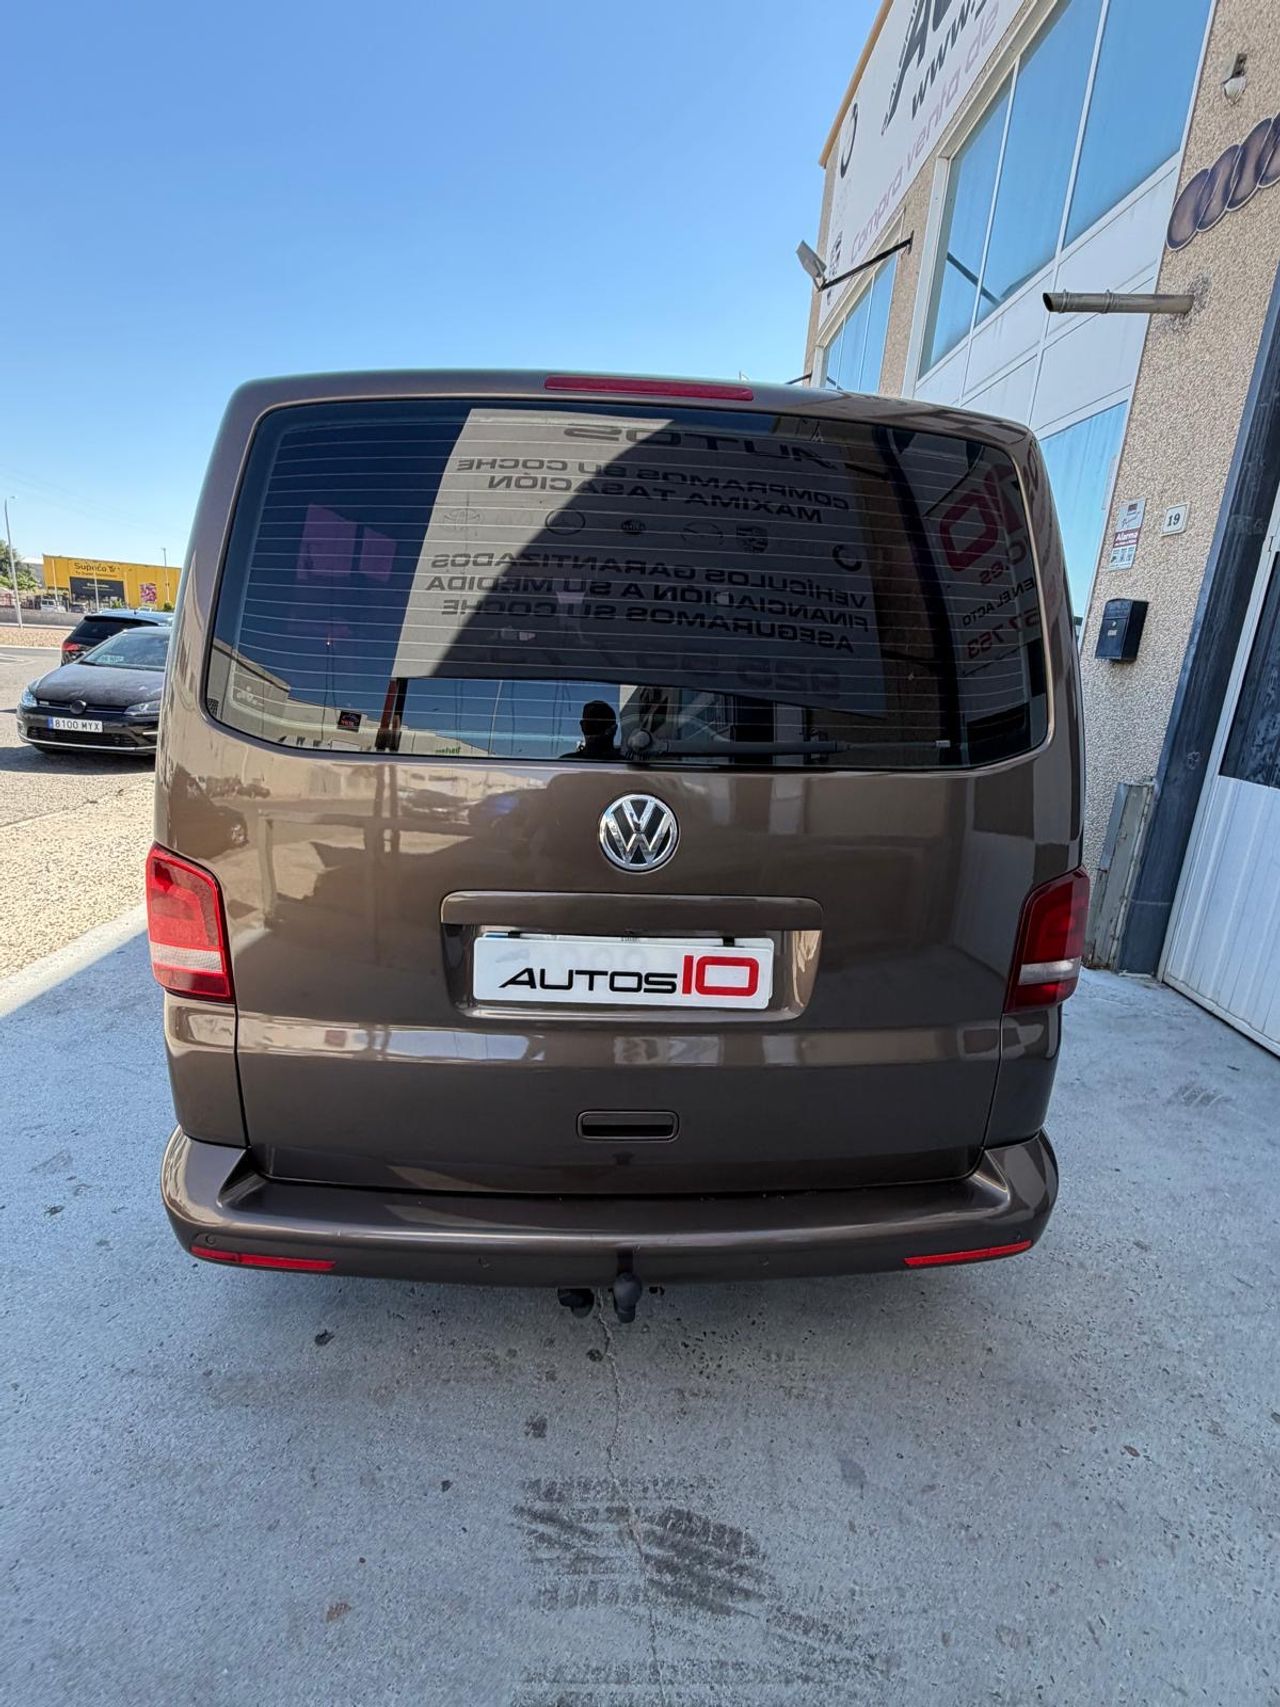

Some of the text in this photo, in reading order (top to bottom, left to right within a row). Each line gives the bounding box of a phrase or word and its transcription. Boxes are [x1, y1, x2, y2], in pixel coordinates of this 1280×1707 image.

[1167, 513, 1181, 527] 19
[55, 717, 100, 731] 8100 MYX
